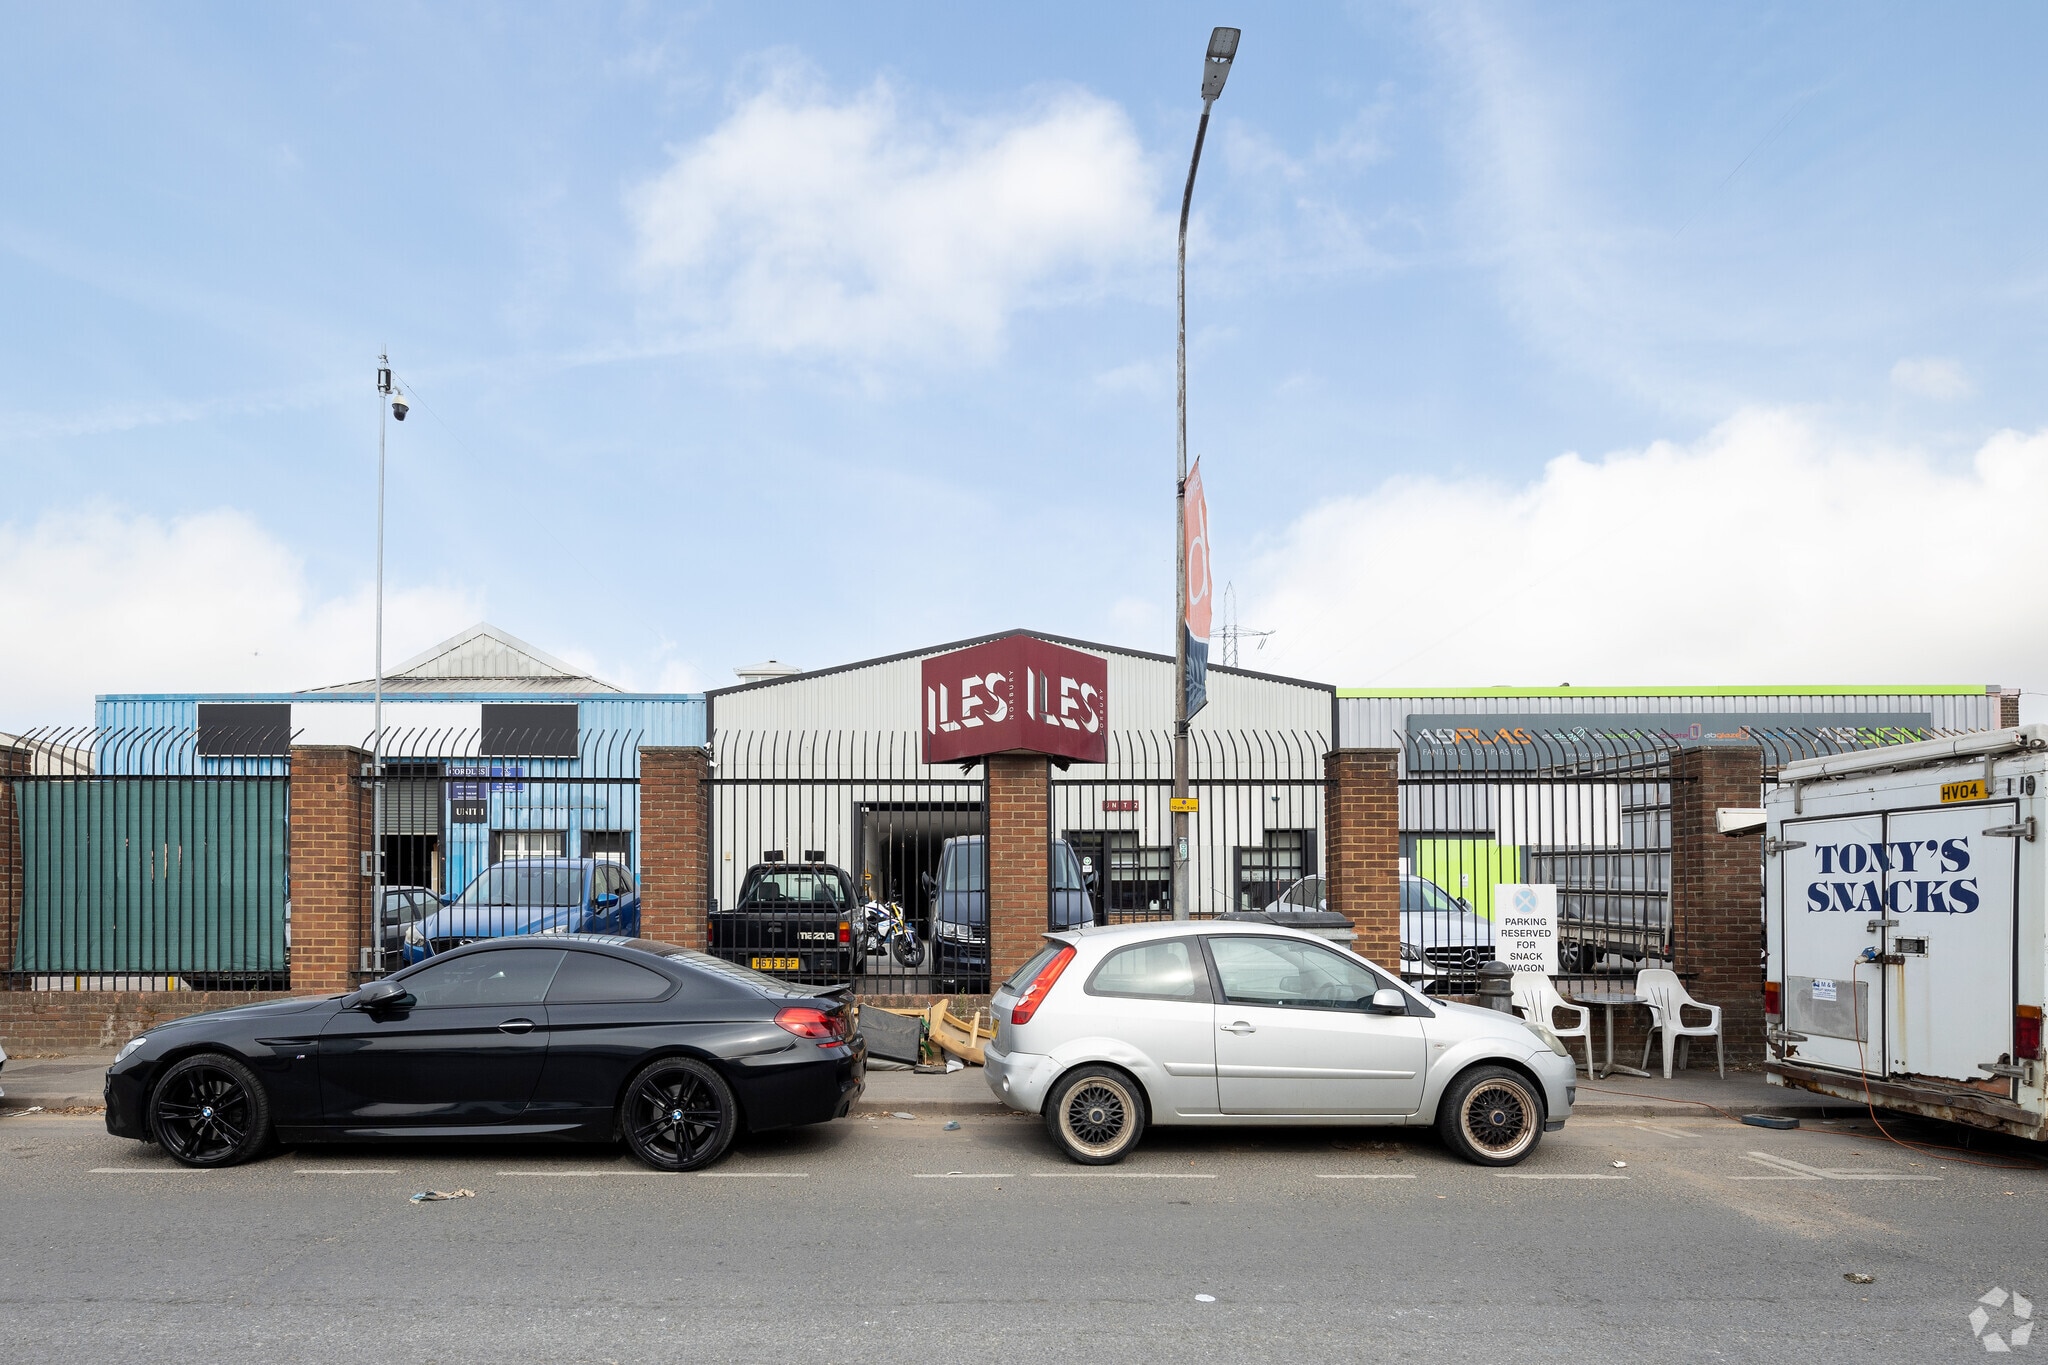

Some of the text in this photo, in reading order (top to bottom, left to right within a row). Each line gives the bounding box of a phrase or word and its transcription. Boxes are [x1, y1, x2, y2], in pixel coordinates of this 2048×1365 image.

[927, 672, 1008, 735] ILES
[1027, 666, 1099, 733] ILES
[1416, 727, 1532, 745] ABPLAS
[1490, 748, 1523, 756] PLASIC
[1942, 783, 1978, 801] HV04
[456, 808, 477, 816] UNIT
[1815, 836, 1971, 874] TONY'S
[1807, 877, 1980, 915] SNACKS
[1505, 918, 1547, 926] PARKING
[1501, 929, 1551, 937] RESERVED
[1516, 941, 1536, 949] FOR
[1509, 952, 1543, 960] SNACK
[1508, 964, 1545, 972] WAGON
